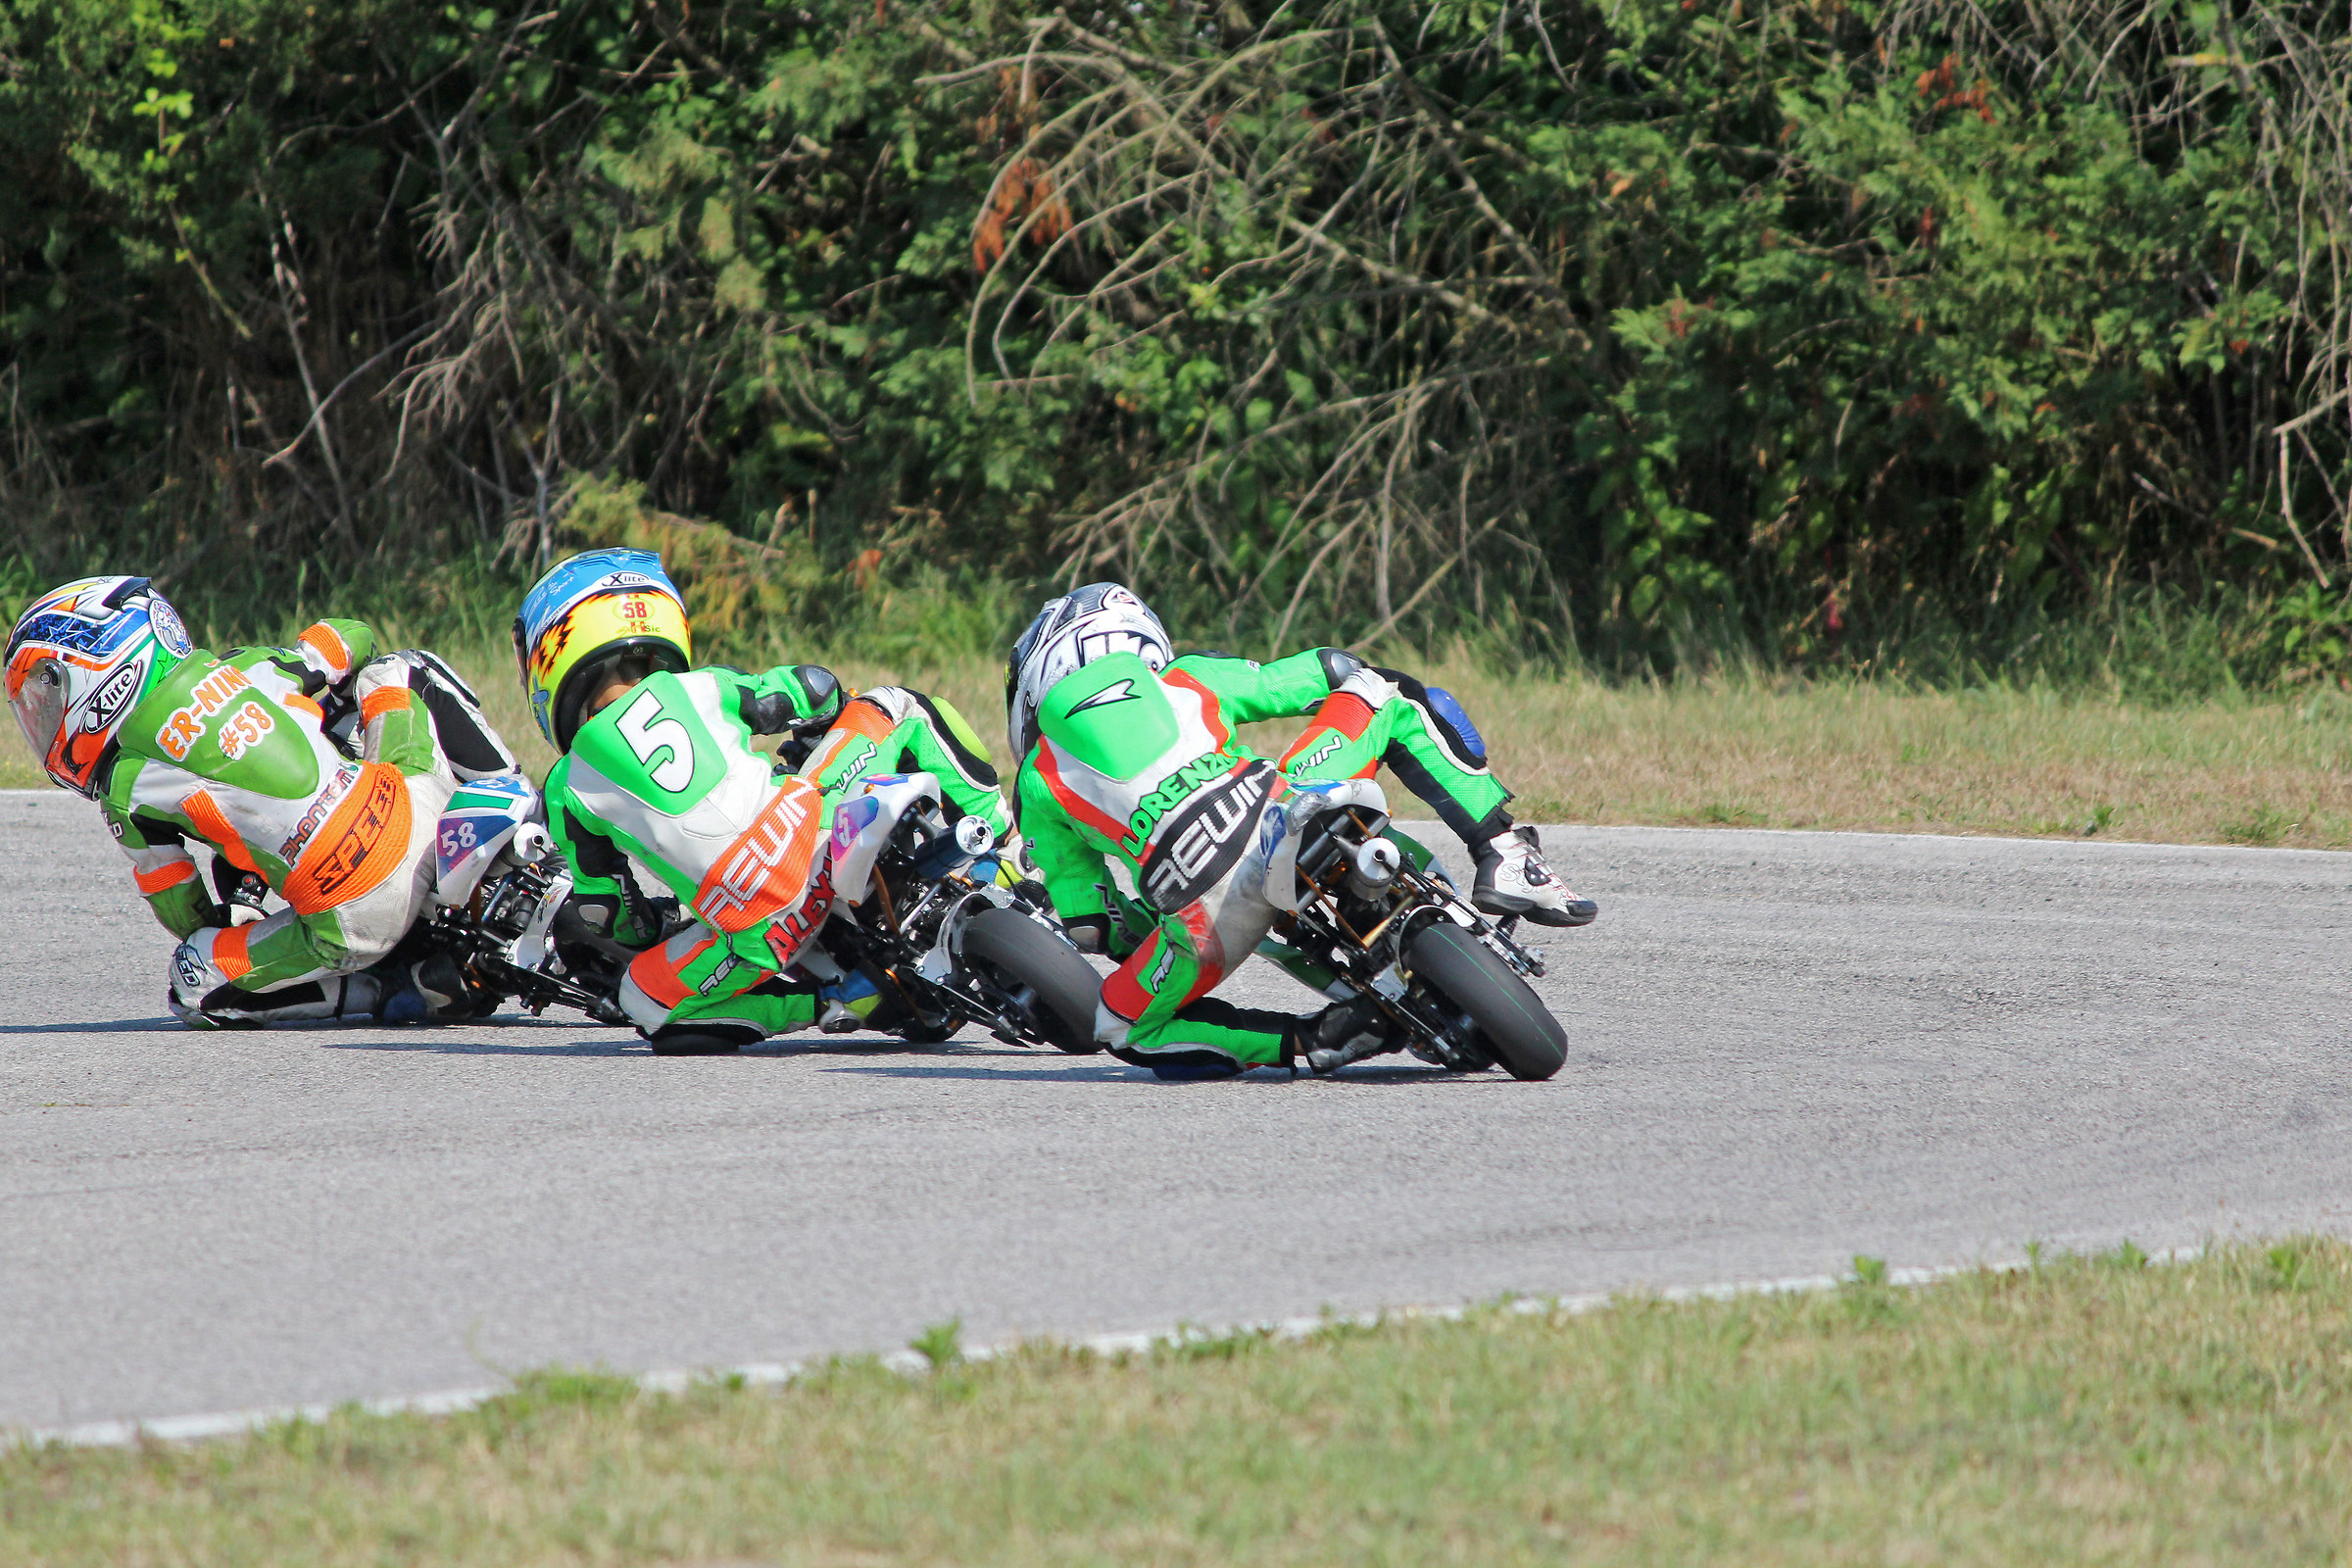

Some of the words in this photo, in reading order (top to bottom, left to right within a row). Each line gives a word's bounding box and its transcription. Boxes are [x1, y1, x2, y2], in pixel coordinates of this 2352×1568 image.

[610, 573, 646, 586] X-lite
[622, 601, 648, 618] 58
[87, 671, 134, 726] X-lite
[220, 704, 271, 756] #58
[613, 688, 694, 794] 5
[1121, 752, 1240, 858] LORENZO
[440, 821, 477, 857] 58
